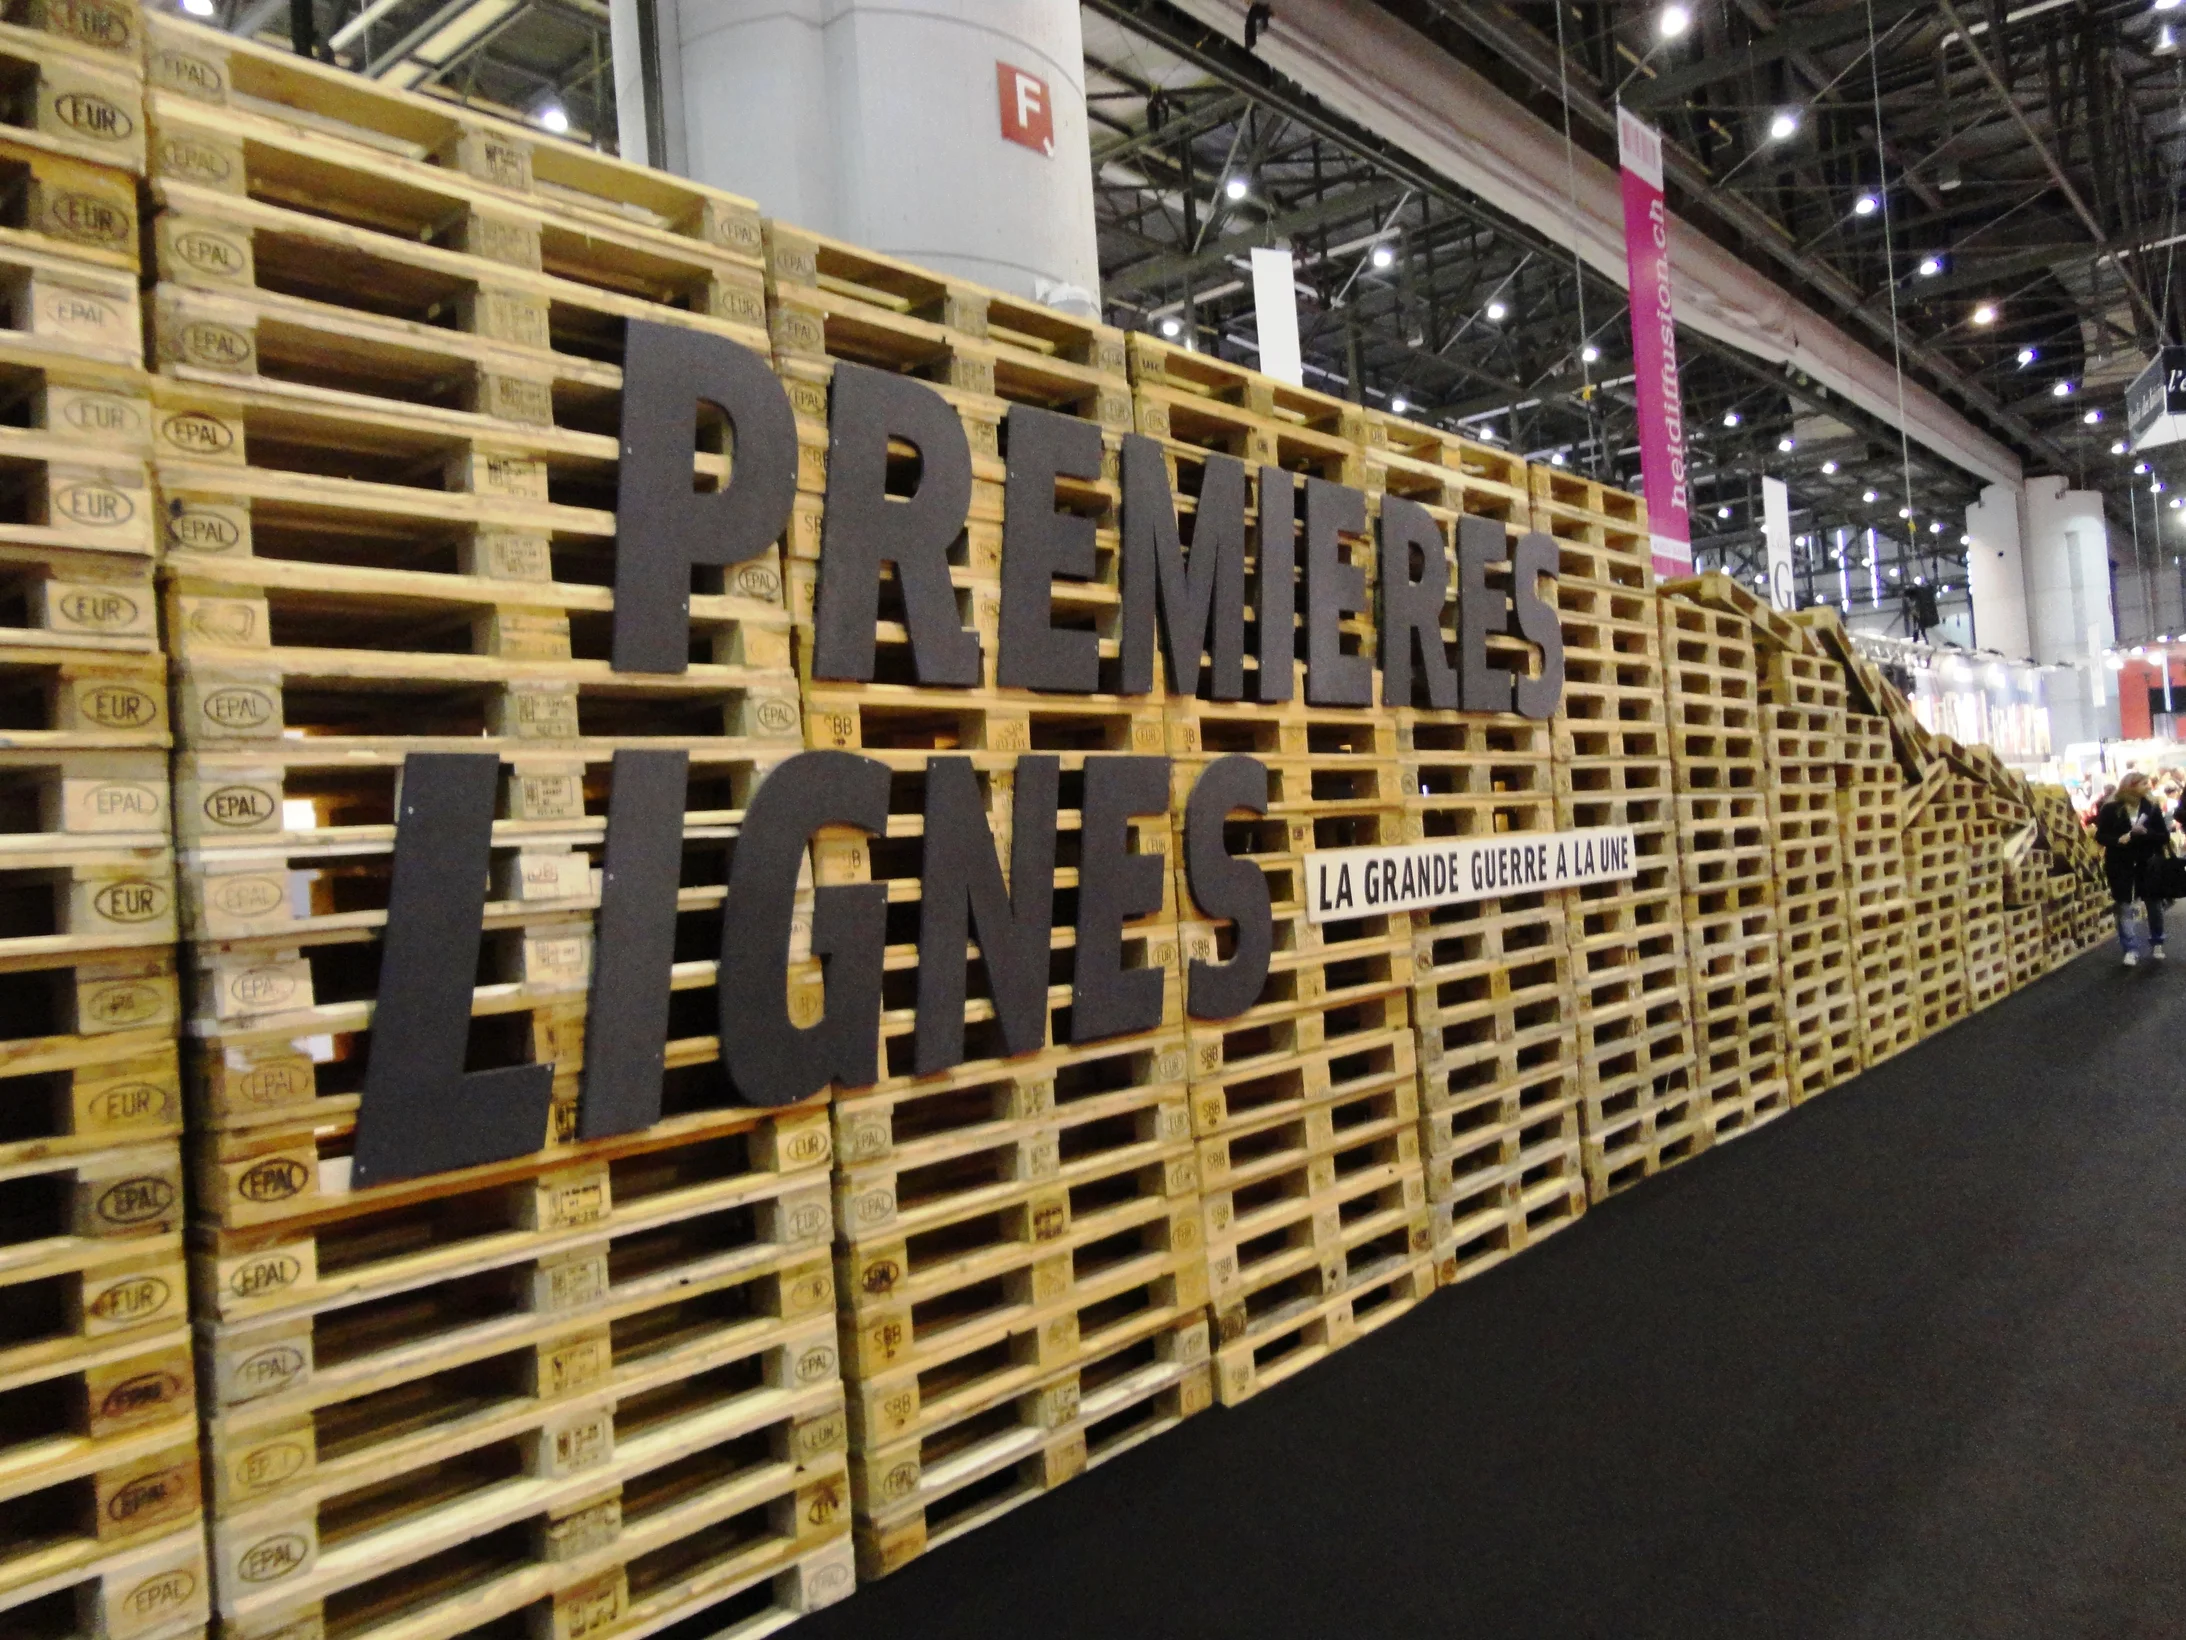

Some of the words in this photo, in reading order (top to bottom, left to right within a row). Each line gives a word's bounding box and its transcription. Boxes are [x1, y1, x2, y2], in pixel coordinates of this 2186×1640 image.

[1015, 72, 1041, 129] F
[71, 101, 117, 132] EUR
[185, 241, 229, 266] EPAL
[193, 330, 236, 354] EPAL
[80, 403, 125, 430] EUR
[175, 423, 218, 445] EPAL
[71, 491, 118, 519] EUR
[611, 317, 1564, 719] PREMIERES
[181, 521, 226, 543] EPAL
[744, 572, 772, 589] EPAL
[76, 601, 121, 622] EUR
[95, 695, 140, 721] EUR
[216, 697, 258, 716] EPAL
[762, 706, 789, 723] EPAL
[96, 793, 147, 815] EPAL
[215, 796, 261, 817] EPAL
[1319, 862, 1353, 911] LA
[1364, 851, 1459, 905] GRANDE
[1471, 844, 1548, 891] GUERRE
[1556, 841, 1568, 880] A
[1575, 839, 1596, 876] LA
[1600, 835, 1629, 872] UNE
[111, 889, 154, 915] EUR
[1192, 939, 1210, 957] SBB
[351, 748, 1273, 1190] LIGNES
[106, 1092, 150, 1117] EUR
[250, 1160, 296, 1193] EPAL
[241, 1261, 288, 1287] EPAL
[111, 1285, 154, 1315] EUR
[802, 1355, 828, 1375] EPAL
[250, 1543, 296, 1569] EPAL
[136, 1579, 183, 1609] EPAL
